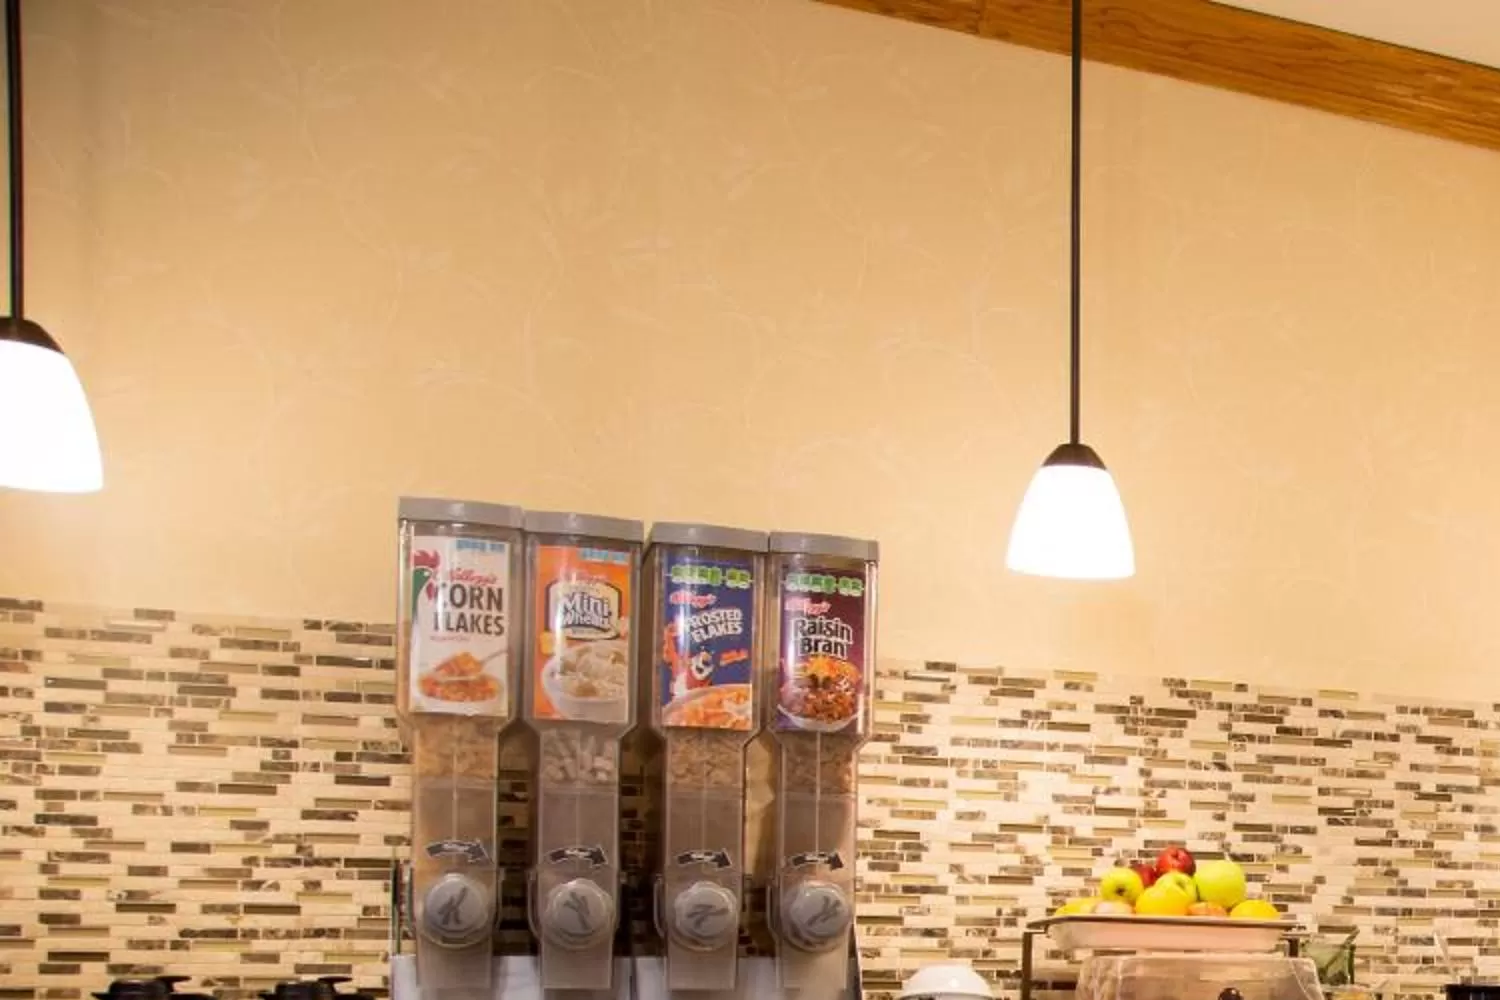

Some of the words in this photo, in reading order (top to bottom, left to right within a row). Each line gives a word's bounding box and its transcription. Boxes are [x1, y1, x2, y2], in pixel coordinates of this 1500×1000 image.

[690, 622, 743, 642] FLAKES
[794, 616, 852, 642] Raisin
[799, 637, 847, 659] Bran
